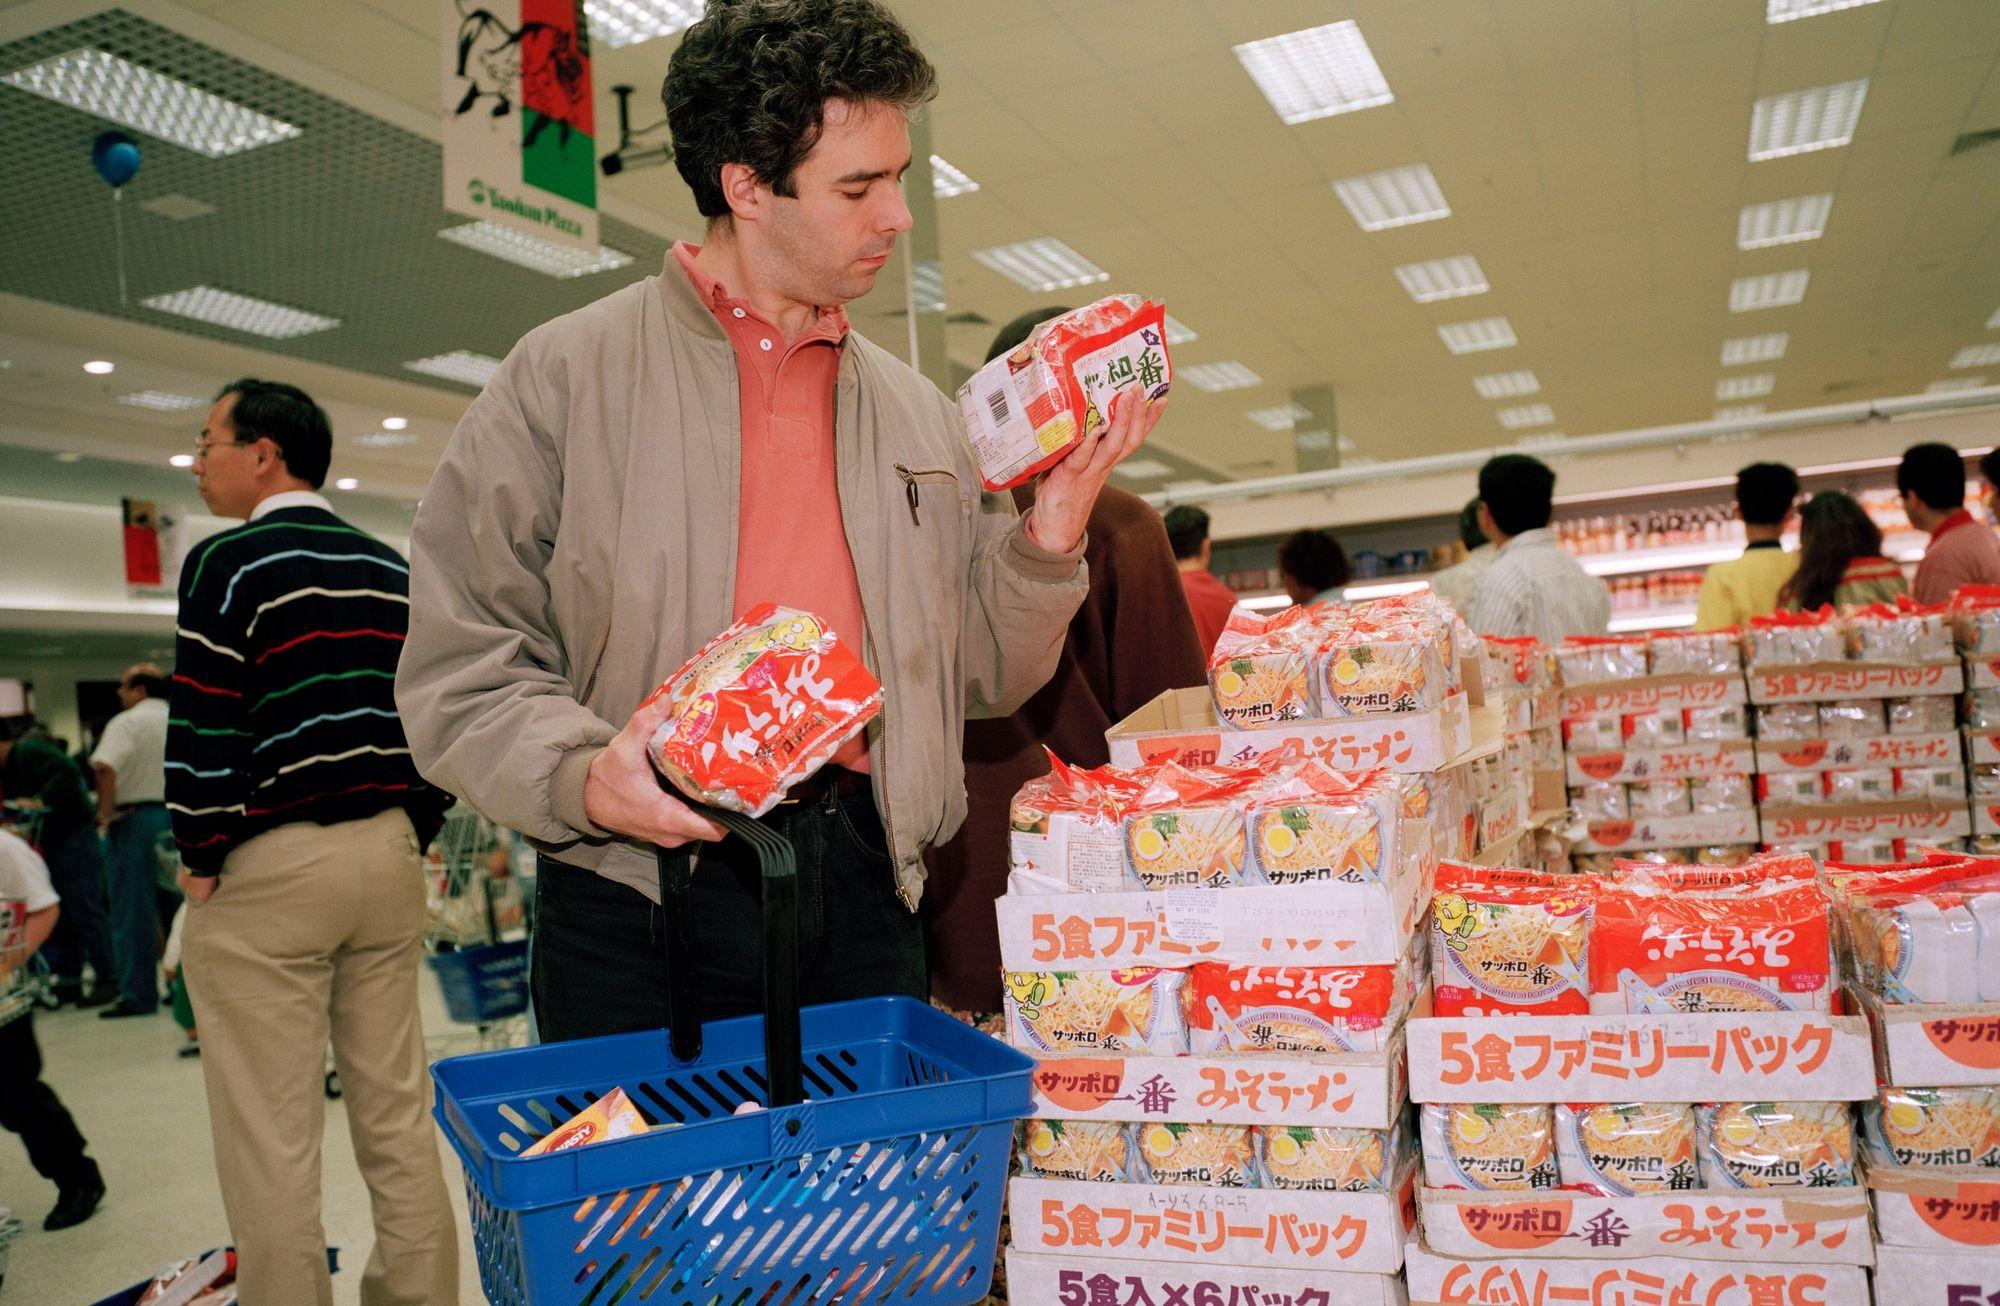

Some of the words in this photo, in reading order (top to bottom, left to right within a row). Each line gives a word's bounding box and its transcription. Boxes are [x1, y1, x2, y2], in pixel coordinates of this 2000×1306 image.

[543, 208, 583, 237] Plaza
[1440, 1024, 1833, 1086] 5食ファミリーパック
[1196, 1066, 1357, 1113] みそラーメン
[1041, 1198, 1368, 1260] 5食ファミリーパック
